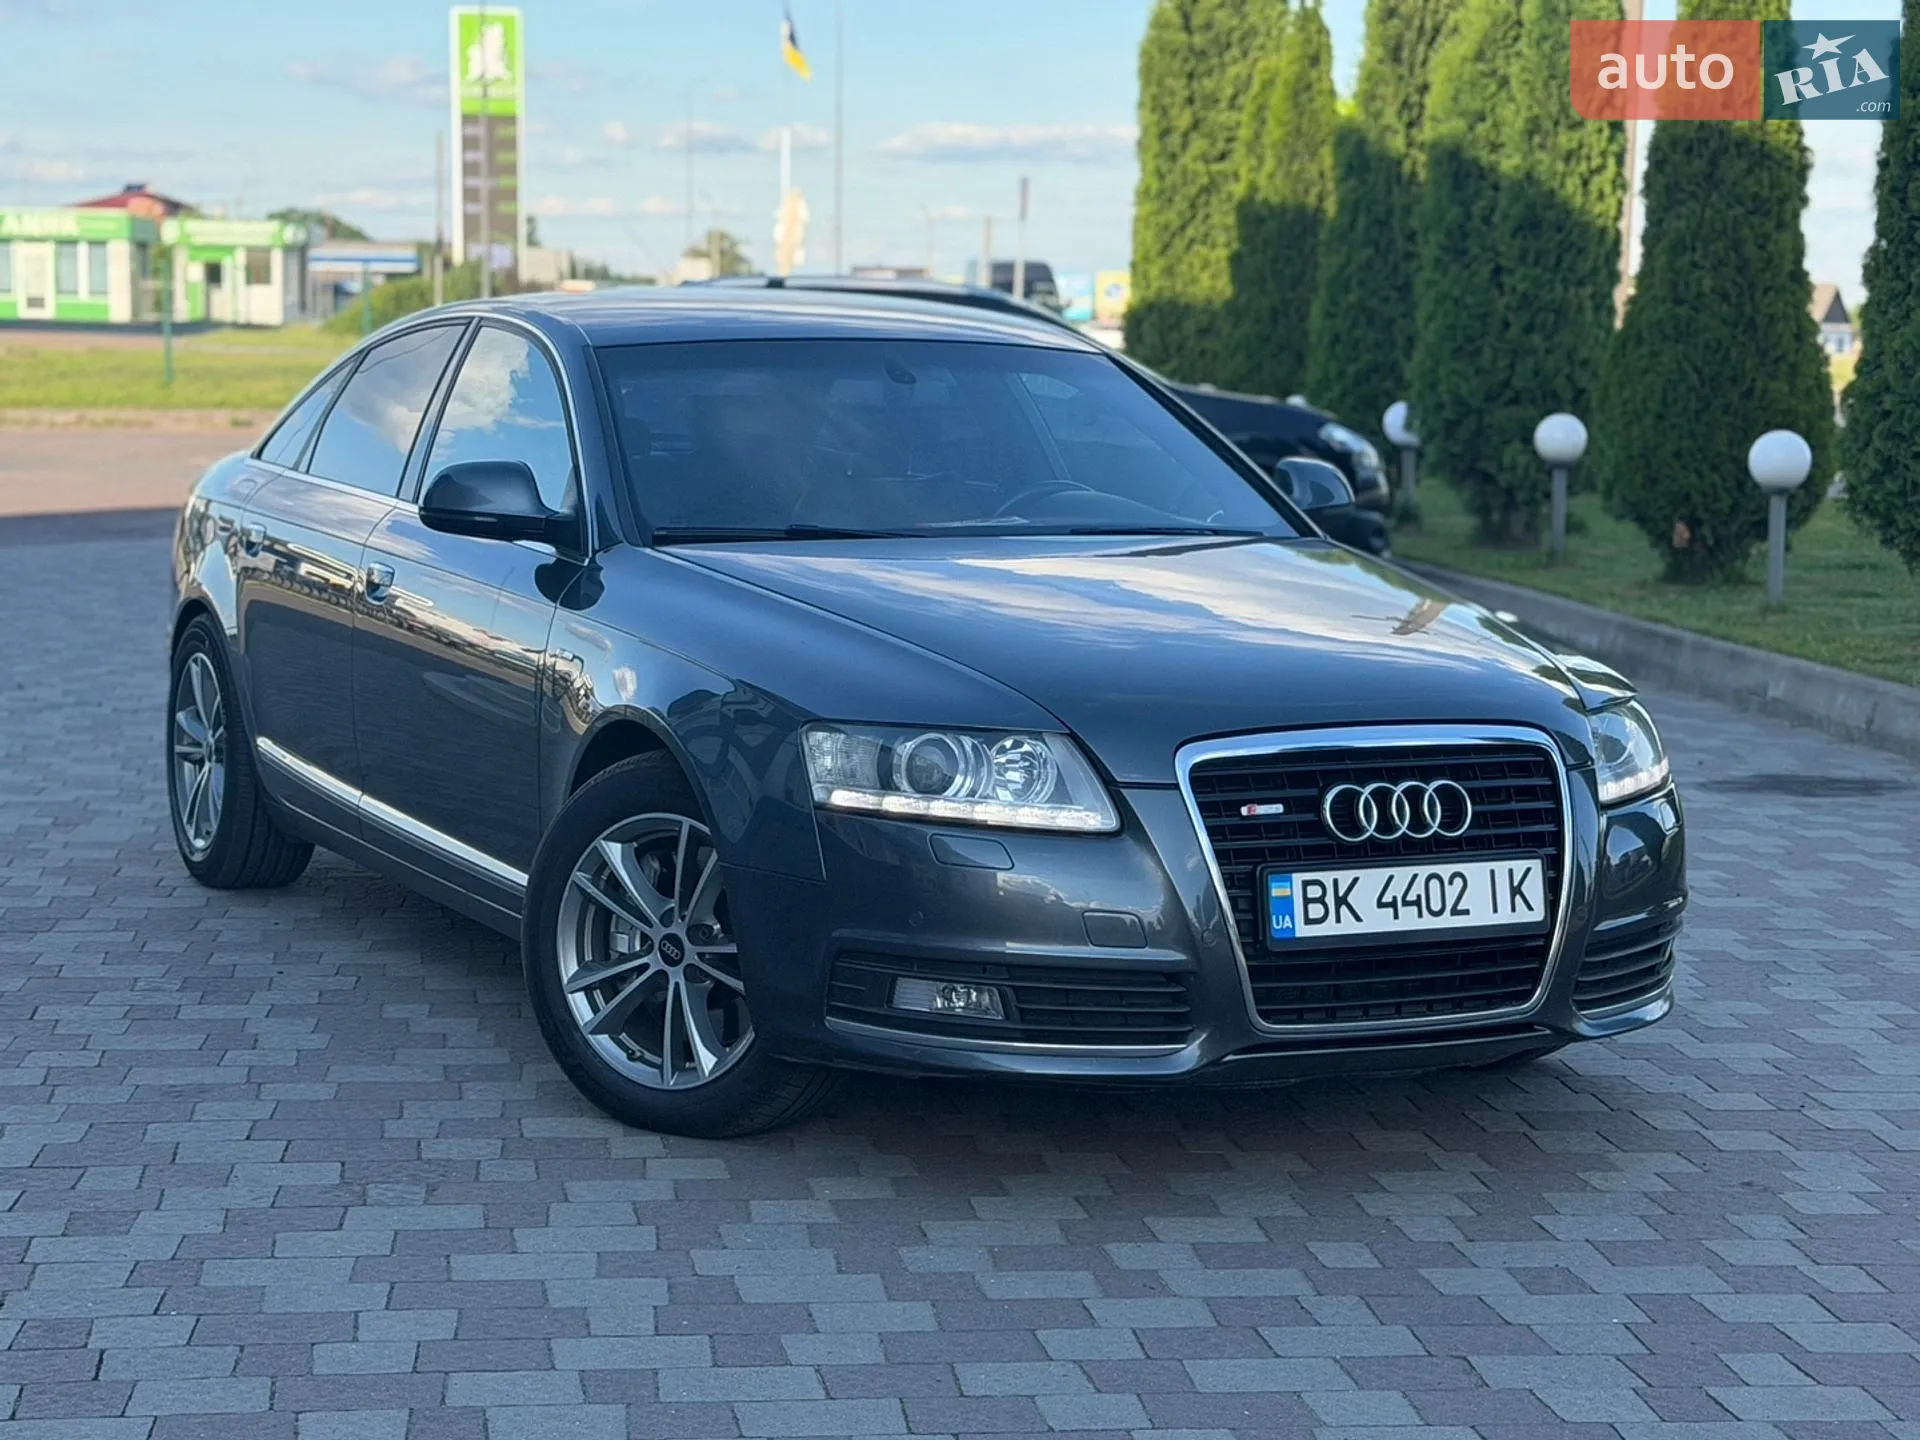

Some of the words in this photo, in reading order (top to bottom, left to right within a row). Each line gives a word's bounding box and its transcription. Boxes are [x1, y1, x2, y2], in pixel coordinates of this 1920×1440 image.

[1301, 876, 1363, 926] BK
[1376, 871, 1470, 920] 4402
[1488, 867, 1535, 914] IK
[1272, 914, 1293, 929] UA
